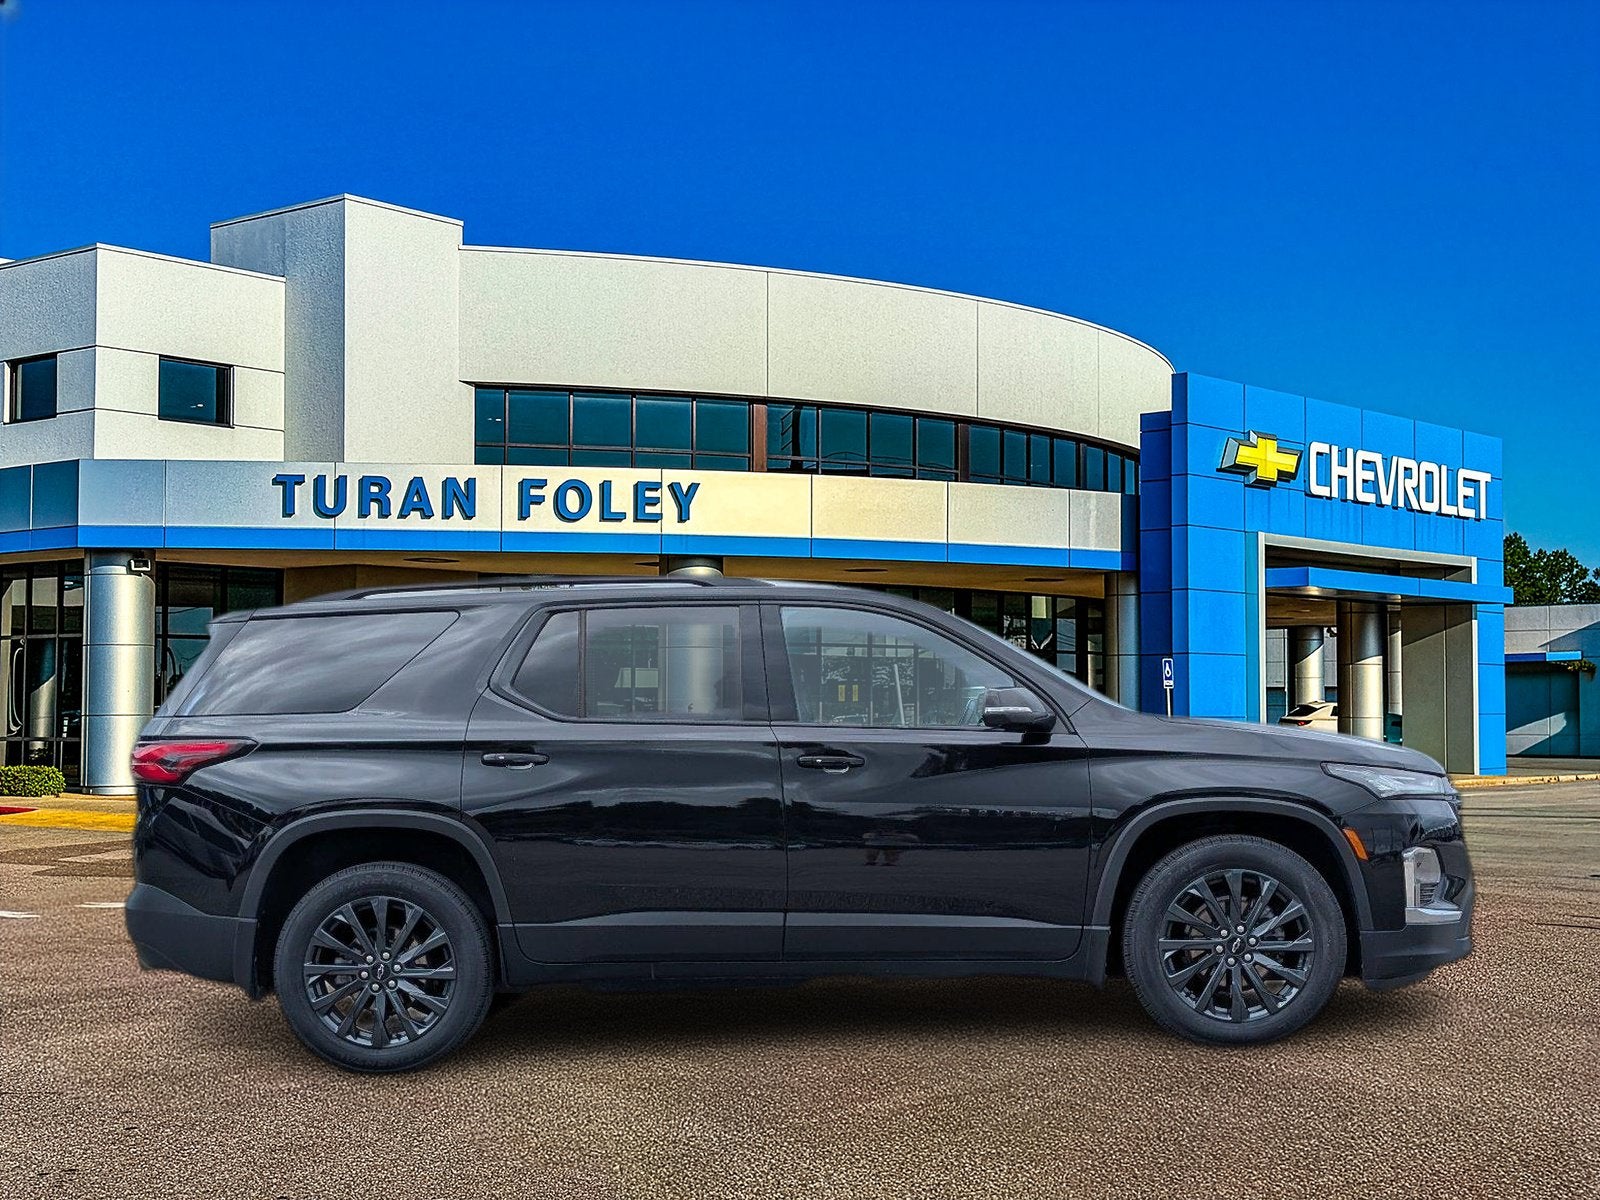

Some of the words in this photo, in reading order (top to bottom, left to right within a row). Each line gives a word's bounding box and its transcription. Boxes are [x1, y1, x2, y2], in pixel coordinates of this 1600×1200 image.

[271, 473, 477, 520] TURAN
[517, 477, 701, 523] FOLEY
[1307, 441, 1492, 520] CHEVROLET
